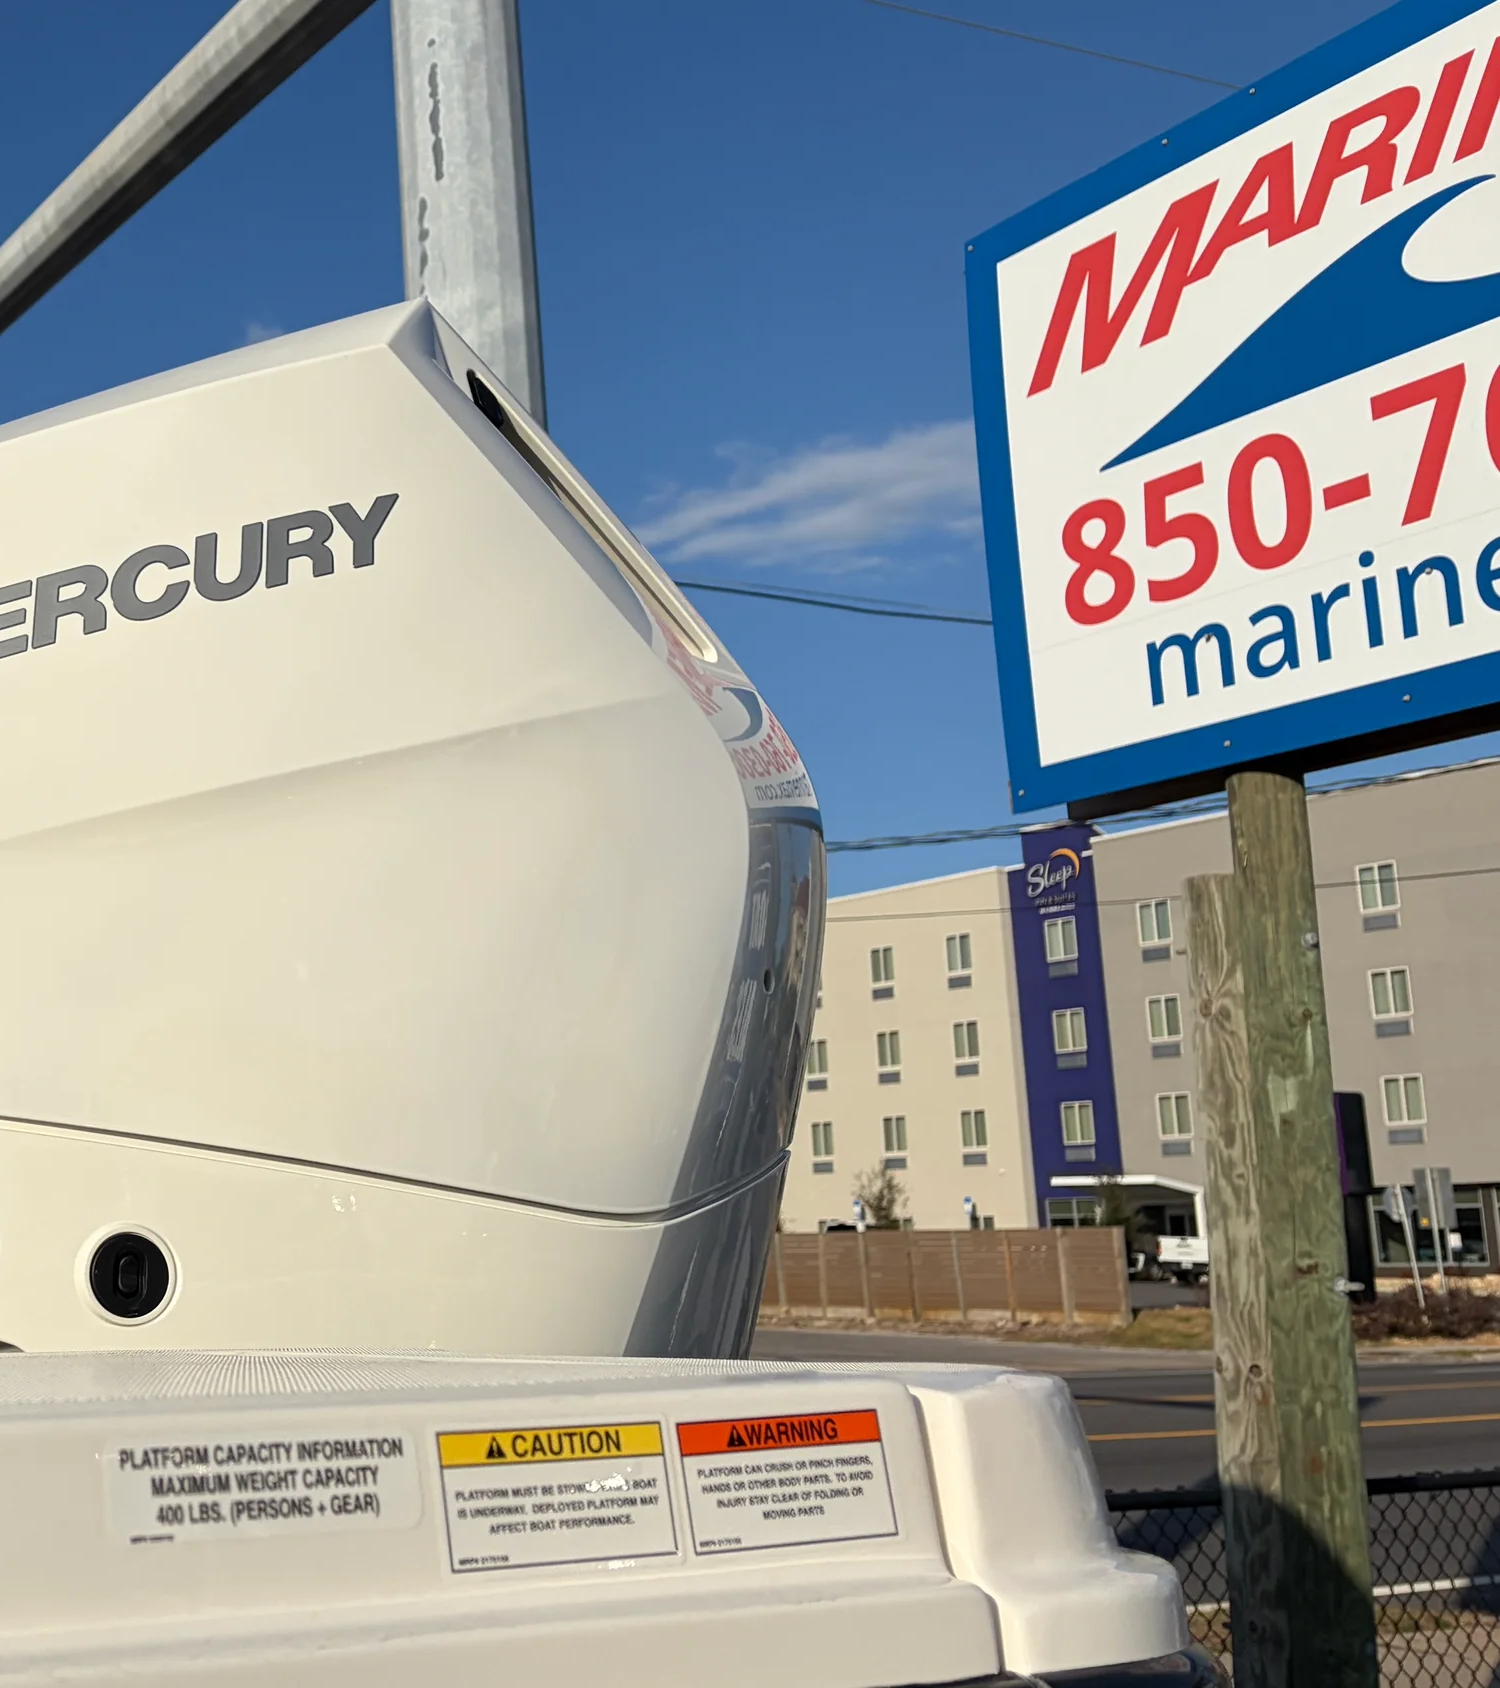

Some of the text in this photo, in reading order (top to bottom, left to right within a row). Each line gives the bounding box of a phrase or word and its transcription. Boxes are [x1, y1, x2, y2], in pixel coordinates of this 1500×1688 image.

[1062, 363, 1500, 626] 850-7
[1027, 860, 1074, 897] Sleep
[511, 1429, 622, 1458] CAUTION
[744, 1418, 838, 1445] WARNING
[119, 1437, 404, 1470] PLATFORM CAPACITY INFORMATION
[151, 1465, 379, 1497] MAXIMUM WEIGHT CAPACITY
[697, 1465, 742, 1479] PLATFORM
[745, 1463, 763, 1475] CAN
[765, 1461, 793, 1473] CRUSH
[796, 1460, 807, 1471] OR
[809, 1458, 834, 1470] PINCH
[455, 1487, 509, 1501] PLATFORM
[512, 1485, 538, 1497] MUST
[541, 1484, 554, 1496] BE
[633, 1478, 658, 1490] BOAT
[702, 1481, 731, 1494] HANDS
[734, 1480, 746, 1492] OR
[748, 1478, 777, 1490] OTHER
[779, 1476, 801, 1488] BODY
[836, 1473, 847, 1483] TO
[849, 1471, 873, 1482] AVOID
[156, 1504, 184, 1526] 400
[189, 1502, 226, 1524] LBS.
[231, 1497, 313, 1523] (PERSONS
[331, 1493, 380, 1519] GEAR)
[457, 1508, 467, 1520] IS
[532, 1500, 584, 1515] DEPLOYED
[587, 1497, 637, 1511] PLATFORM
[640, 1496, 659, 1508] MAY
[717, 1487, 864, 1508] INJURY STAY CLEAR OF FOLDING OR
[763, 1505, 825, 1520] MOVING PARTS
[489, 1522, 526, 1535] AFFECT
[530, 1520, 556, 1532] BOAT
